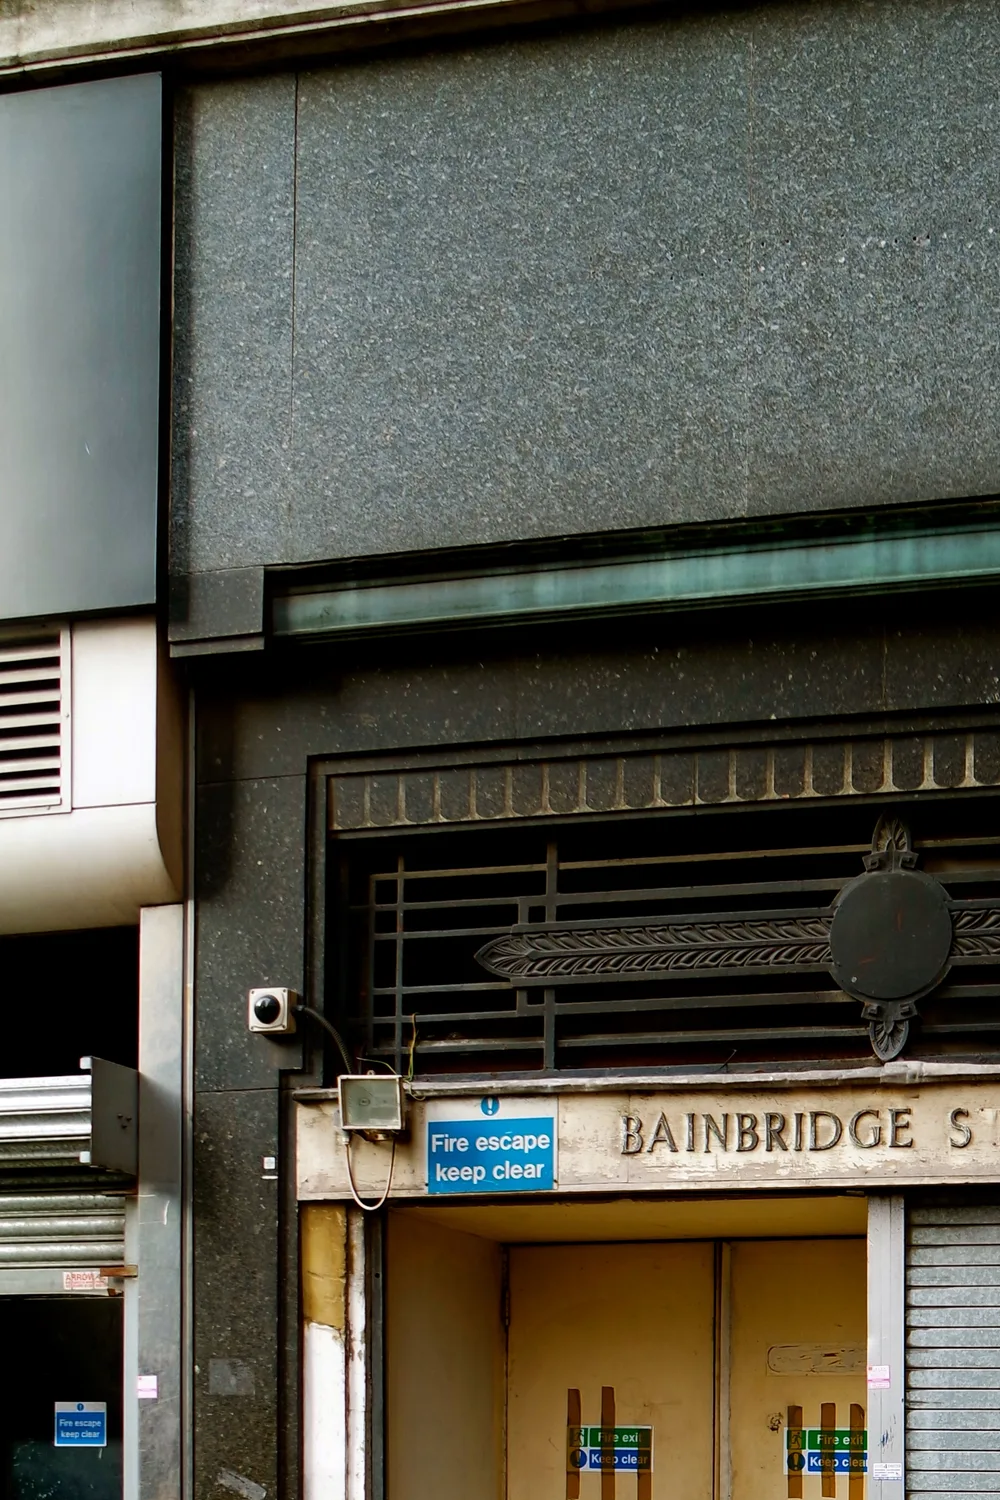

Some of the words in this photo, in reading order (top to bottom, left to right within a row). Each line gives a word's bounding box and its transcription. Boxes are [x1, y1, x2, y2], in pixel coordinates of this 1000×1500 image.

[620, 1107, 915, 1155] BAINBRIDGE
[431, 1133, 469, 1153] Fire
[475, 1133, 551, 1154] escape
[435, 1163, 486, 1184] keep
[492, 1160, 545, 1179] clear
[59, 1419, 73, 1427] Fire
[74, 1419, 102, 1428] escape
[60, 1430, 80, 1439] keep
[80, 1430, 100, 1438] clear
[597, 1432, 619, 1443] Fire
[622, 1432, 642, 1443] exit
[816, 1434, 839, 1445] Fire
[842, 1434, 864, 1445] exit
[591, 1453, 619, 1465] Keep
[621, 1453, 648, 1465] clear
[810, 1456, 839, 1469] Keep
